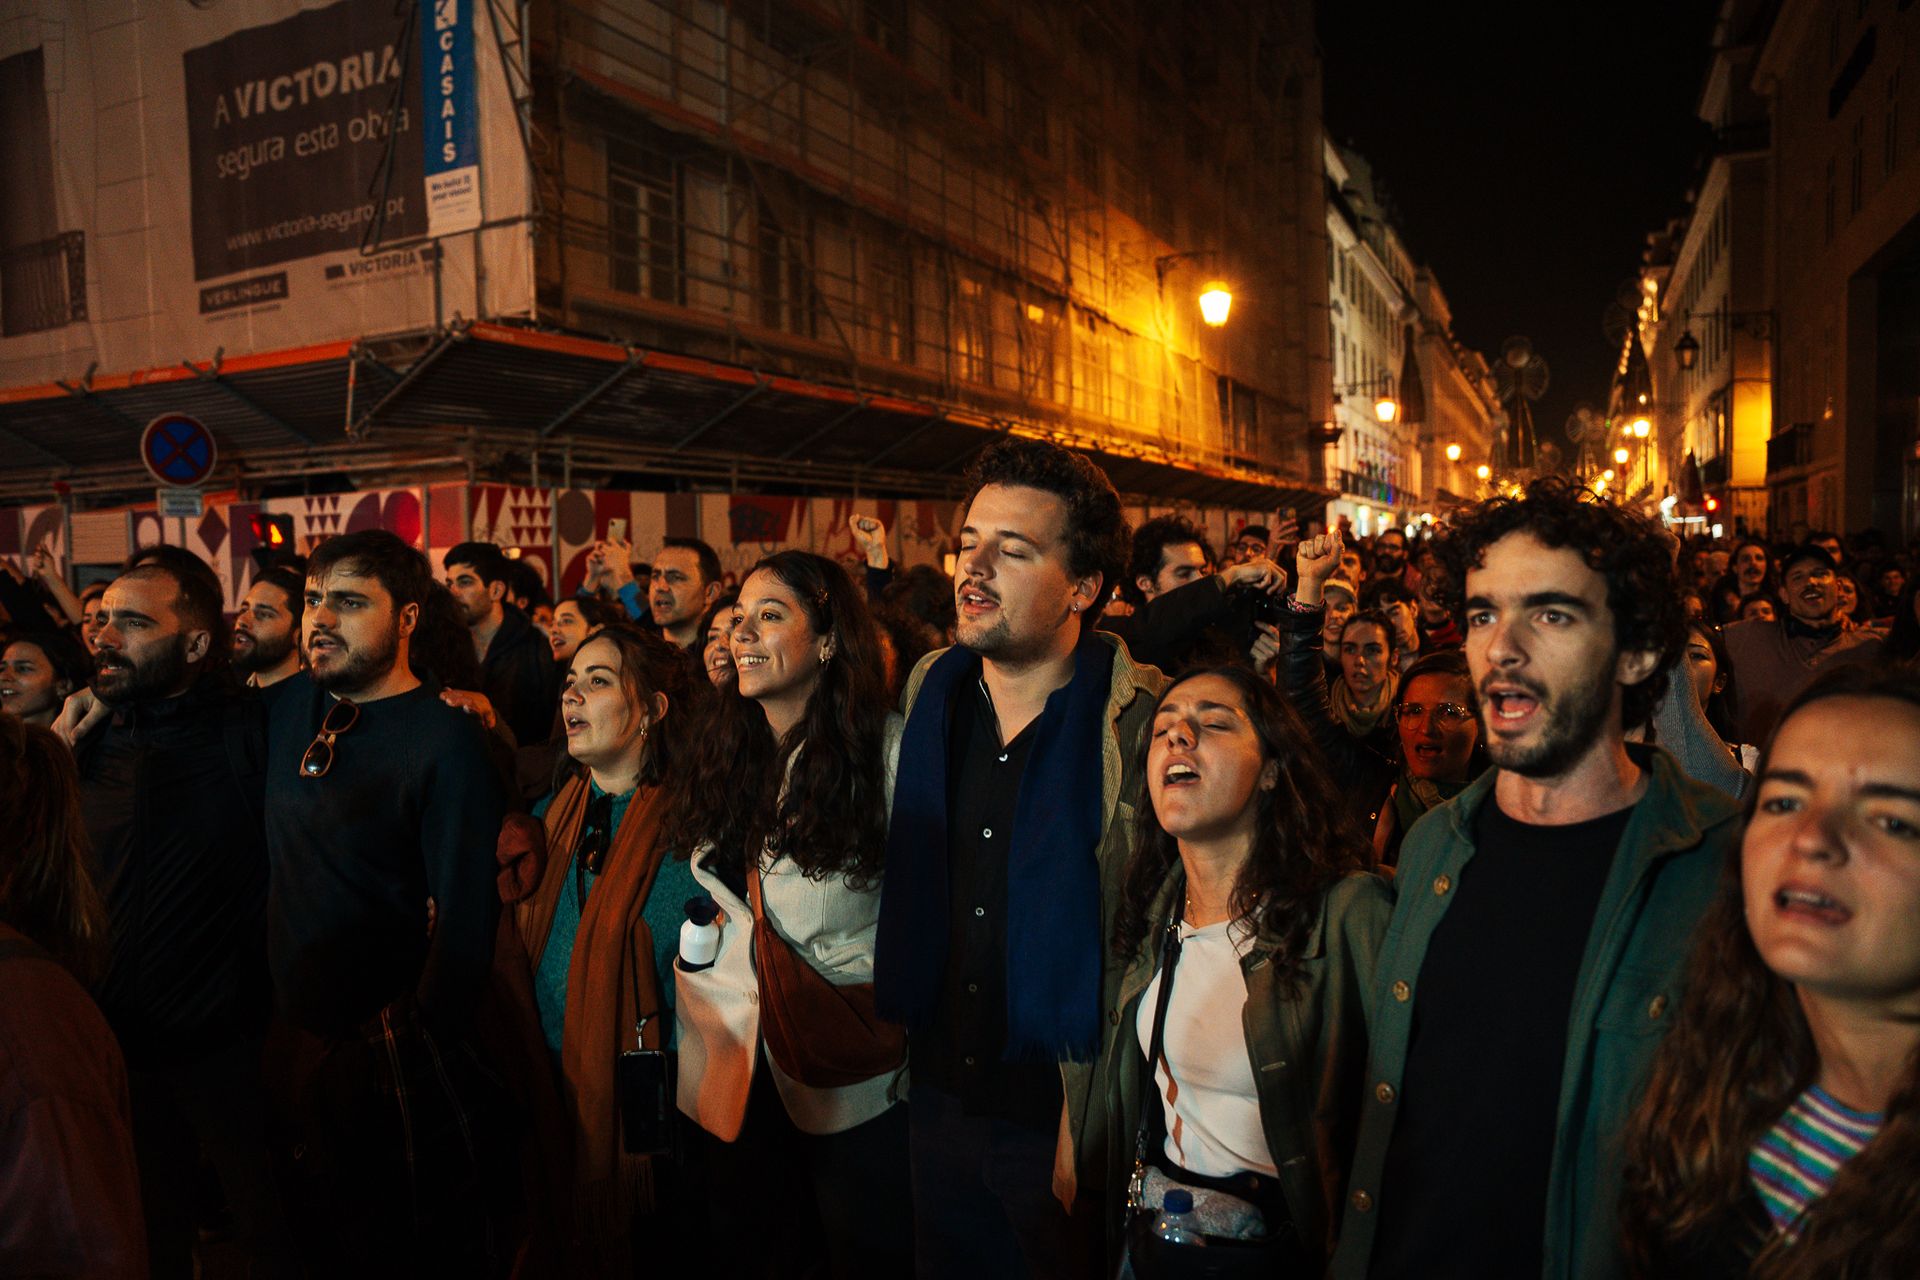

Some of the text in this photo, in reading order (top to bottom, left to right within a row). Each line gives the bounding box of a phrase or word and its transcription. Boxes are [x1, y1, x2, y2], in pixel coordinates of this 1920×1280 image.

[213, 44, 402, 130] A VICTORIA
[438, 30, 457, 164] CASAIS
[217, 136, 286, 181] segura
[295, 121, 340, 157] esta
[349, 251, 417, 275] VICTORIA
